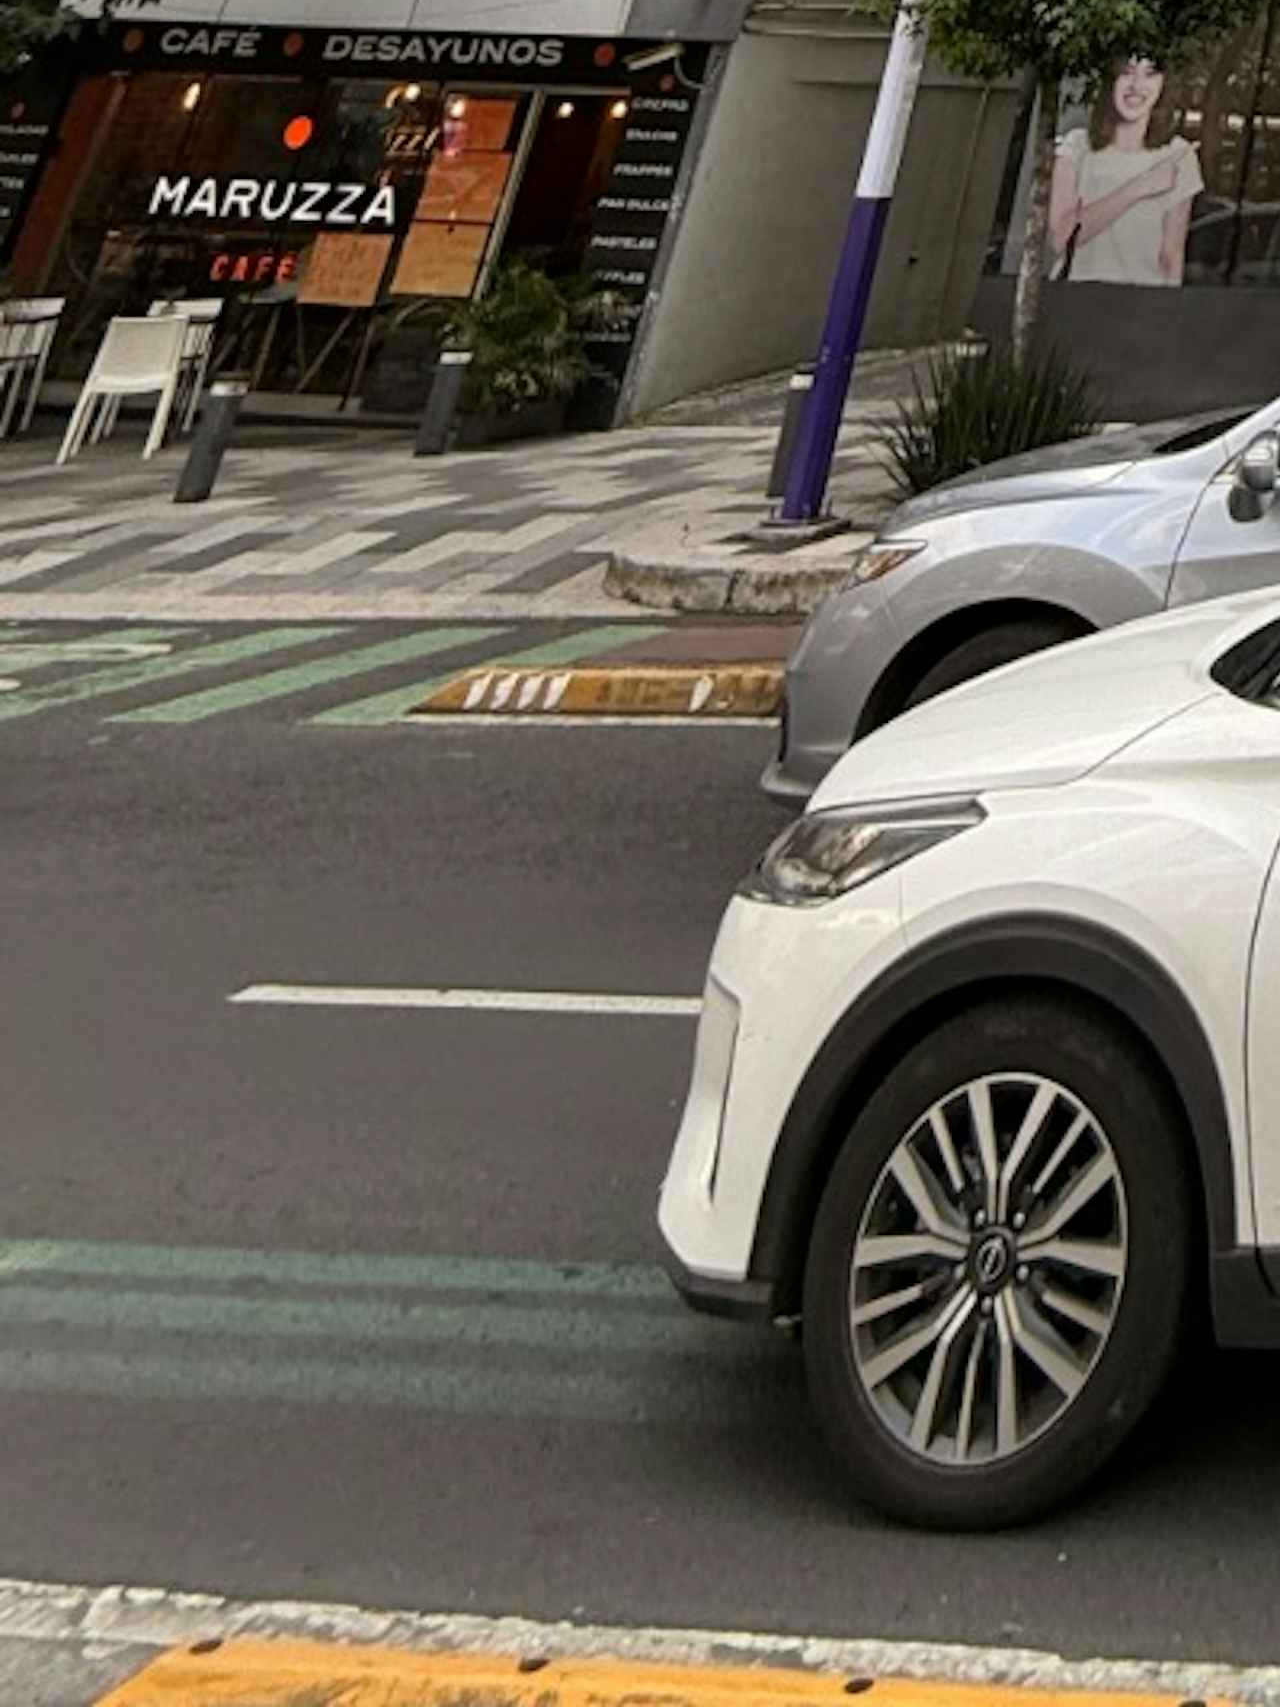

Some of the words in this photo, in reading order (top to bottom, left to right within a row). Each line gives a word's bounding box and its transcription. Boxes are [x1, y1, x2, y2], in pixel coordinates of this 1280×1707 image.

[160, 25, 262, 58] CAFÉ
[322, 35, 565, 66] DESAYUNOS
[148, 176, 396, 227] MARUZZA
